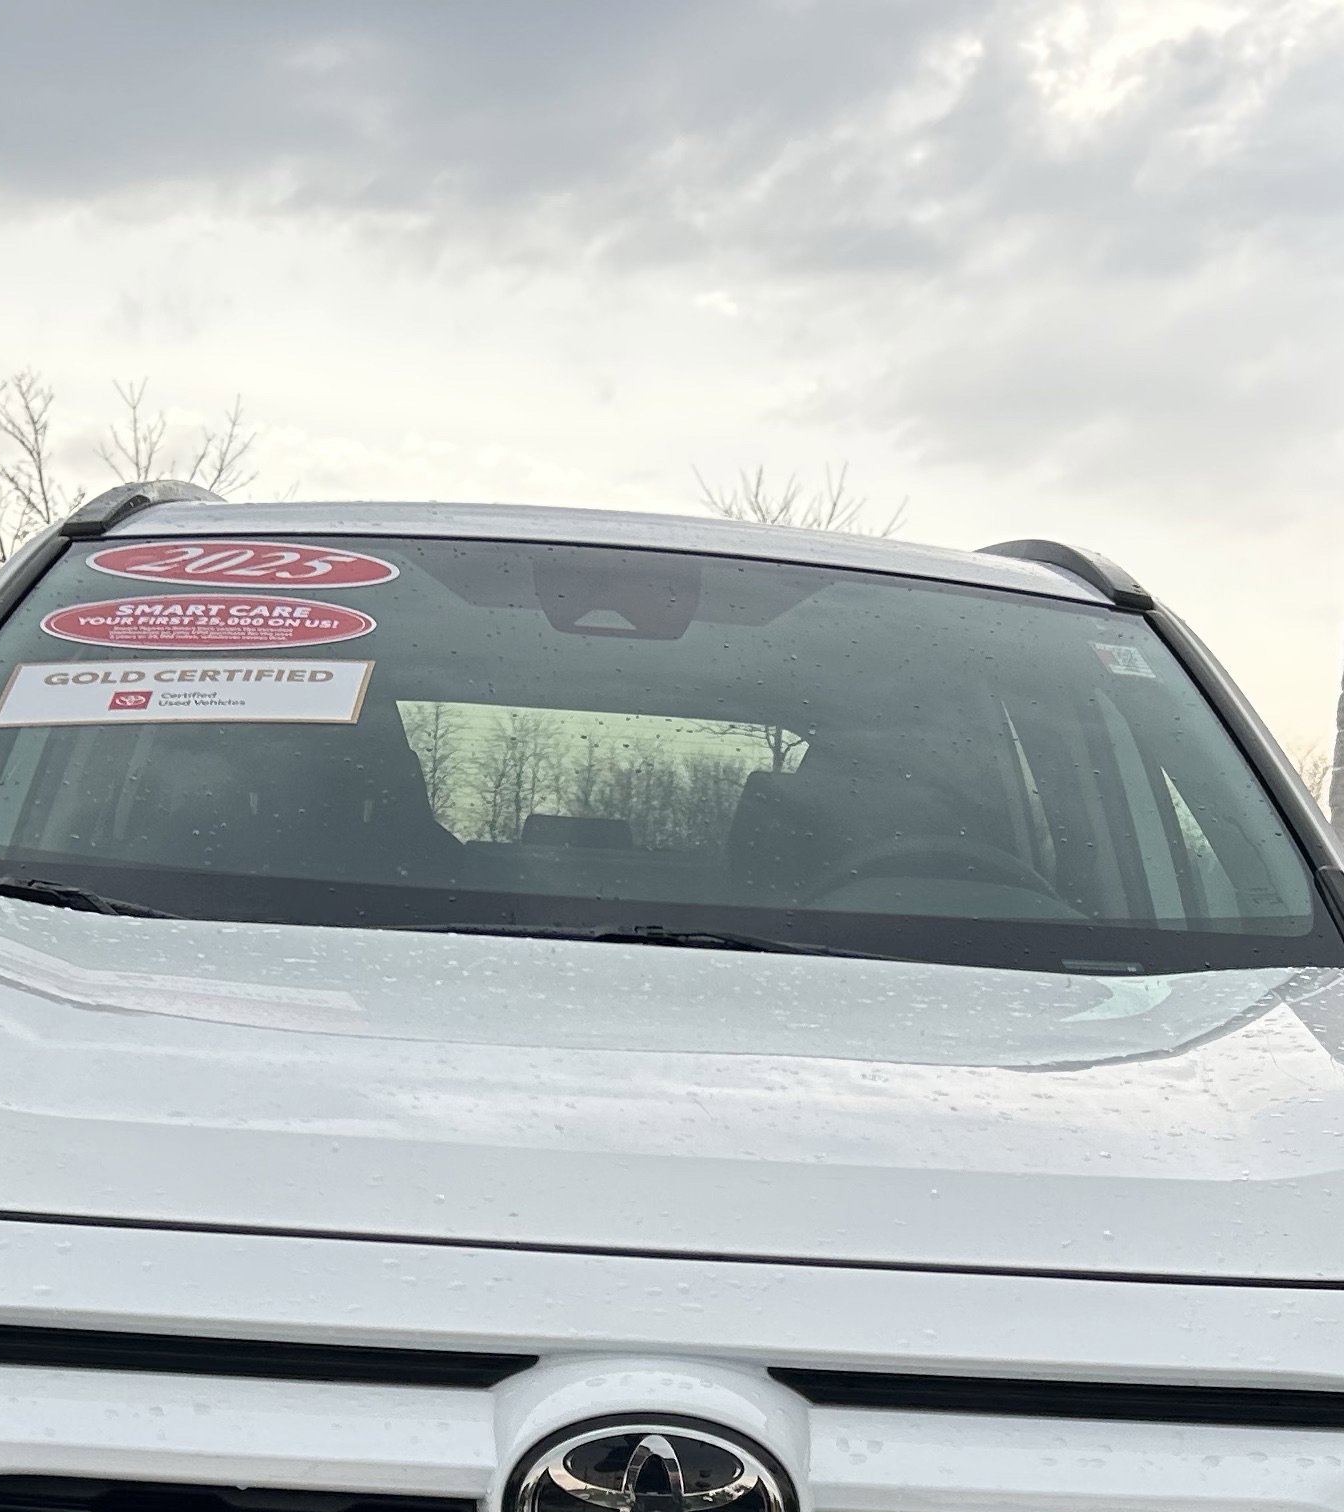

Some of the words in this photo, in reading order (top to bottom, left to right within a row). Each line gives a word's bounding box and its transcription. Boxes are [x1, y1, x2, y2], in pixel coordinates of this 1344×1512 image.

[126, 548, 357, 578] 2025
[116, 604, 226, 617] SMART
[229, 605, 311, 618] CARE
[78, 616, 134, 626] YOUR
[137, 616, 194, 626] FIRST
[267, 618, 300, 627] ON
[304, 619, 340, 629] US!
[43, 670, 146, 686] GOLD
[153, 669, 334, 683] CERTIFIED
[161, 691, 217, 699] Certified
